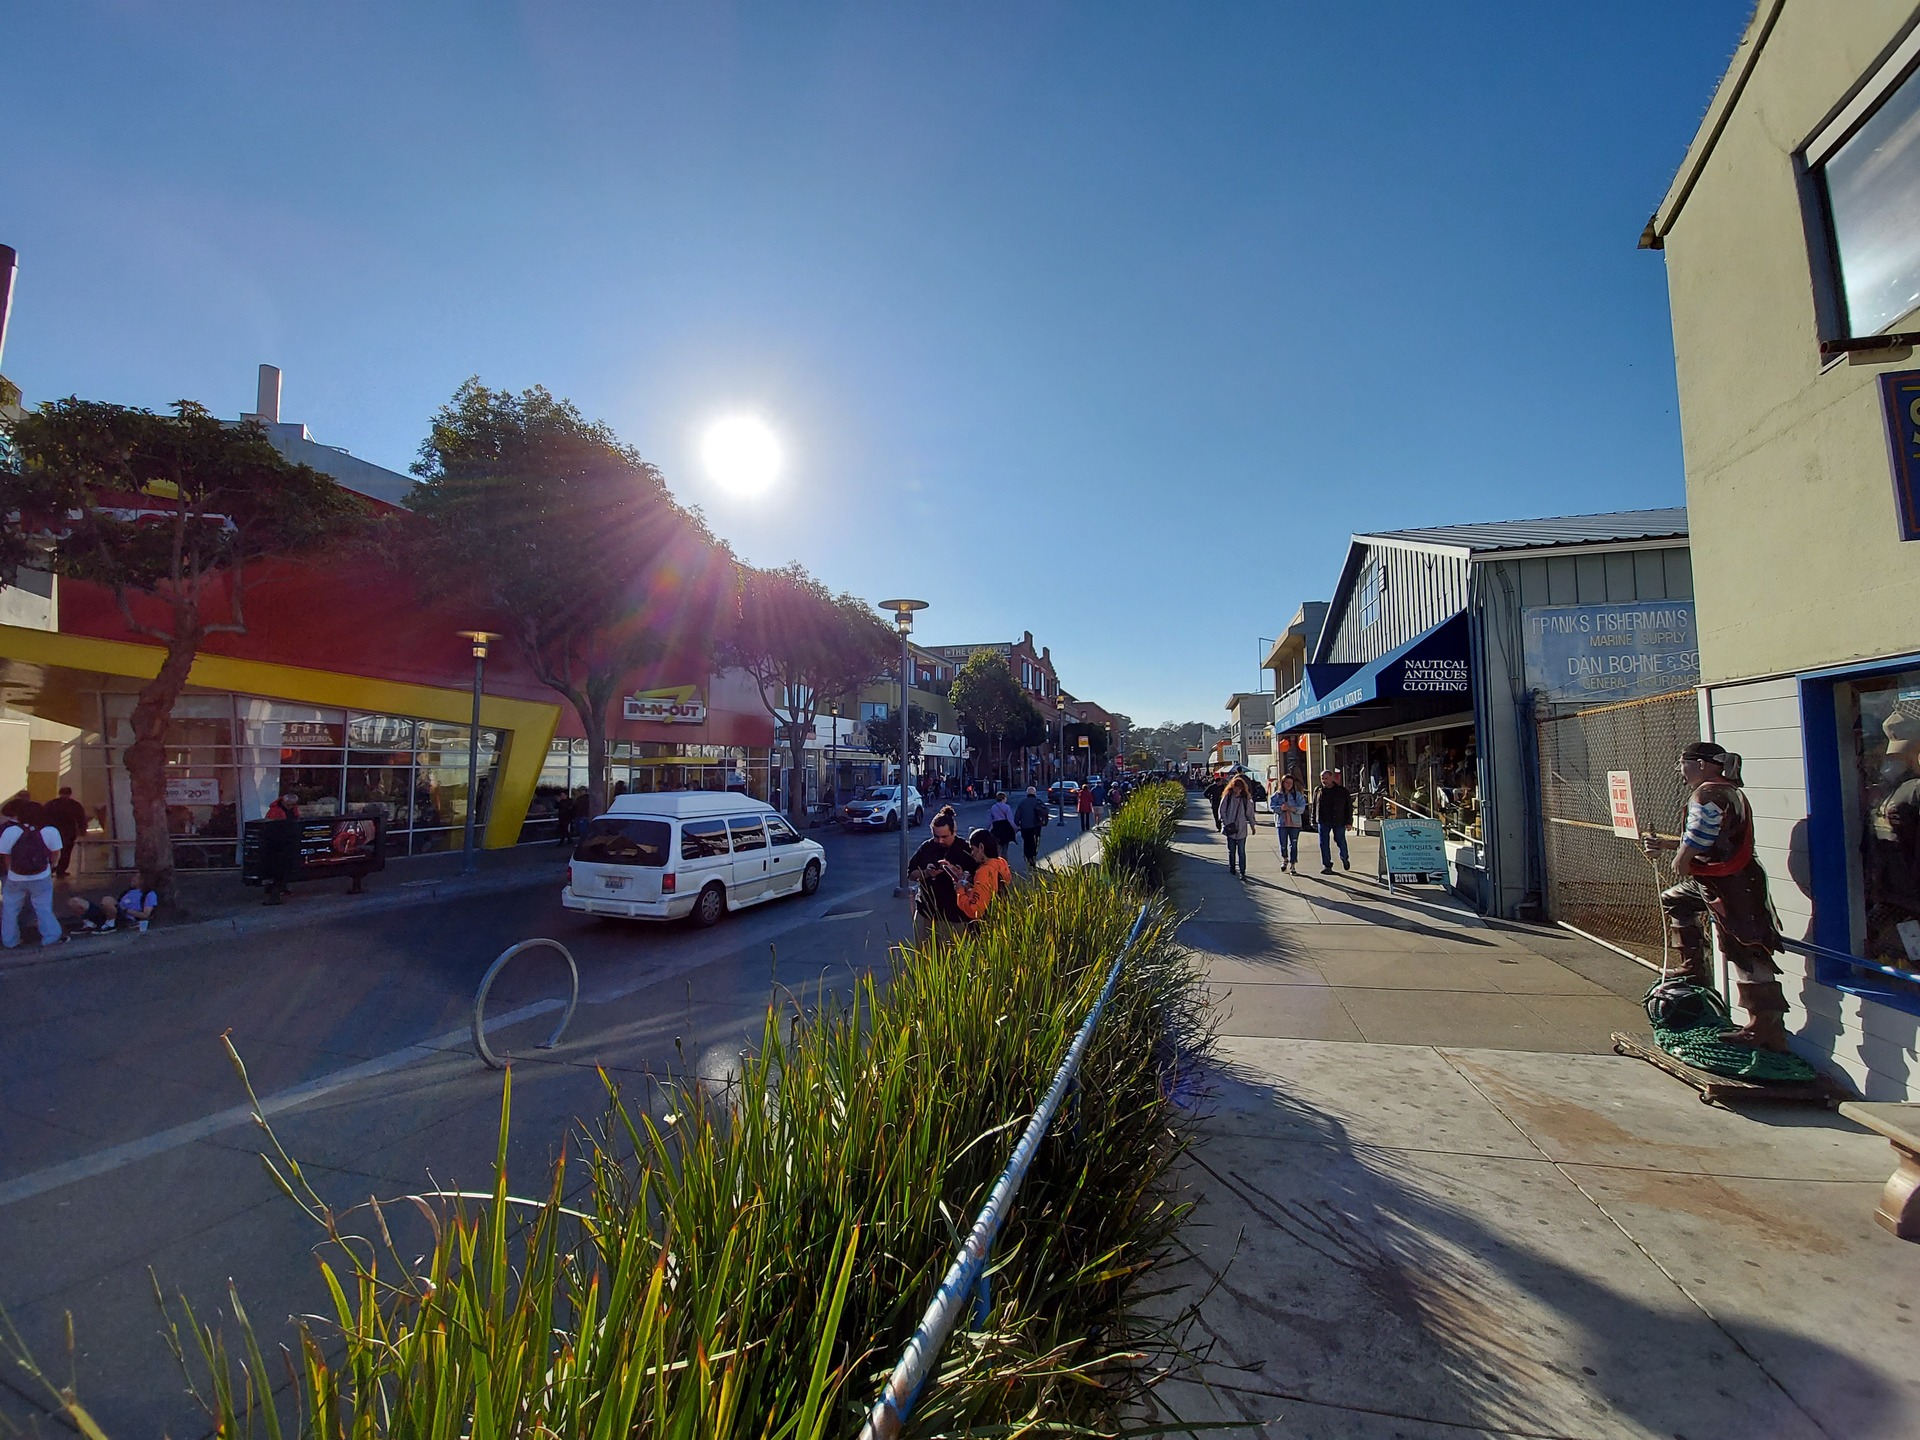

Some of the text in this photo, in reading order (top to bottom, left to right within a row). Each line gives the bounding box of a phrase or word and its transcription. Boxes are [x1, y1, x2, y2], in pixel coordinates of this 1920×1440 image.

[1590, 631, 1687, 647] MARINE SUPPLY
[1405, 660, 1468, 669] NAUTICAL
[1567, 656, 1603, 675] DAN
[1609, 653, 1663, 674] BOHNE
[1666, 655, 1676, 669] &
[1404, 670, 1467, 680] ANTIQUES
[1403, 682, 1467, 691] CLOTHING
[1582, 676, 1628, 690] GENERAL
[628, 703, 699, 716] IN-N-OUT
[1612, 788, 1627, 800] DO NOT
[1615, 802, 1629, 814] BLOCK
[1614, 815, 1634, 828] DRIVEWAY
[1394, 874, 1418, 882] ENTER
